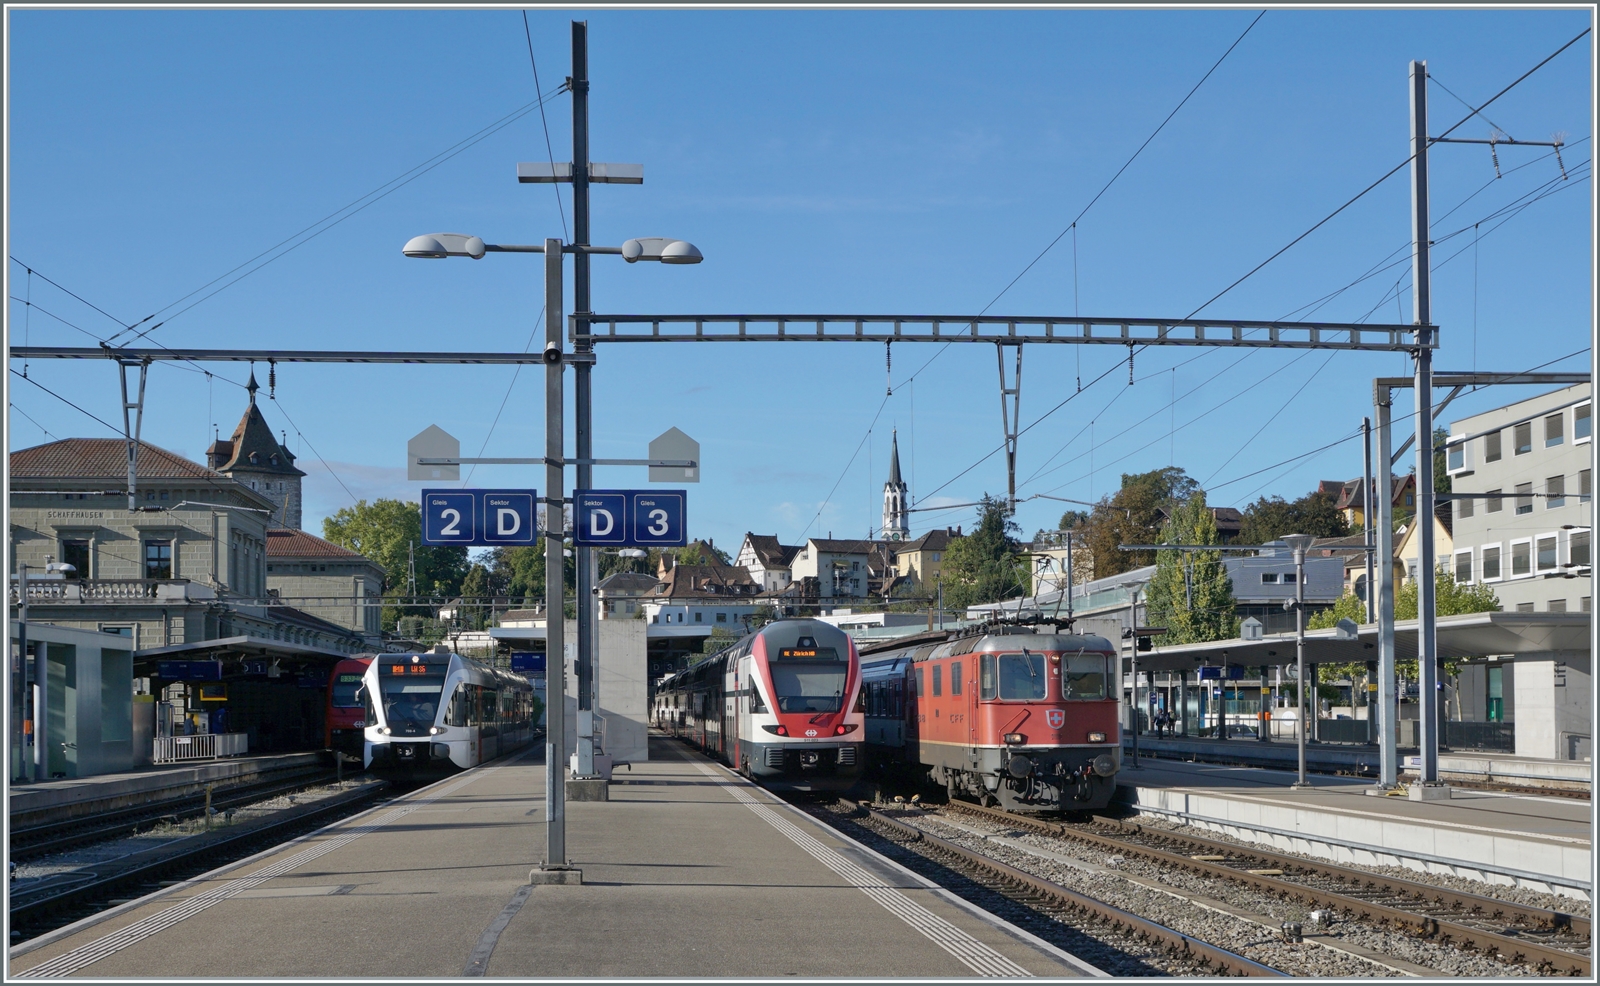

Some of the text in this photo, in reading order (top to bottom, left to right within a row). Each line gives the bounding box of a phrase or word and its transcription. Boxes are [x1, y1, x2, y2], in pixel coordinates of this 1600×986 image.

[47, 511, 104, 519] SCHAFFHAUSEN
[440, 508, 521, 536] 2 D
[590, 508, 669, 537] D 3
[653, 663, 673, 671] D 3
[1554, 662, 1566, 687] Lift
[950, 714, 964, 723] CFF
